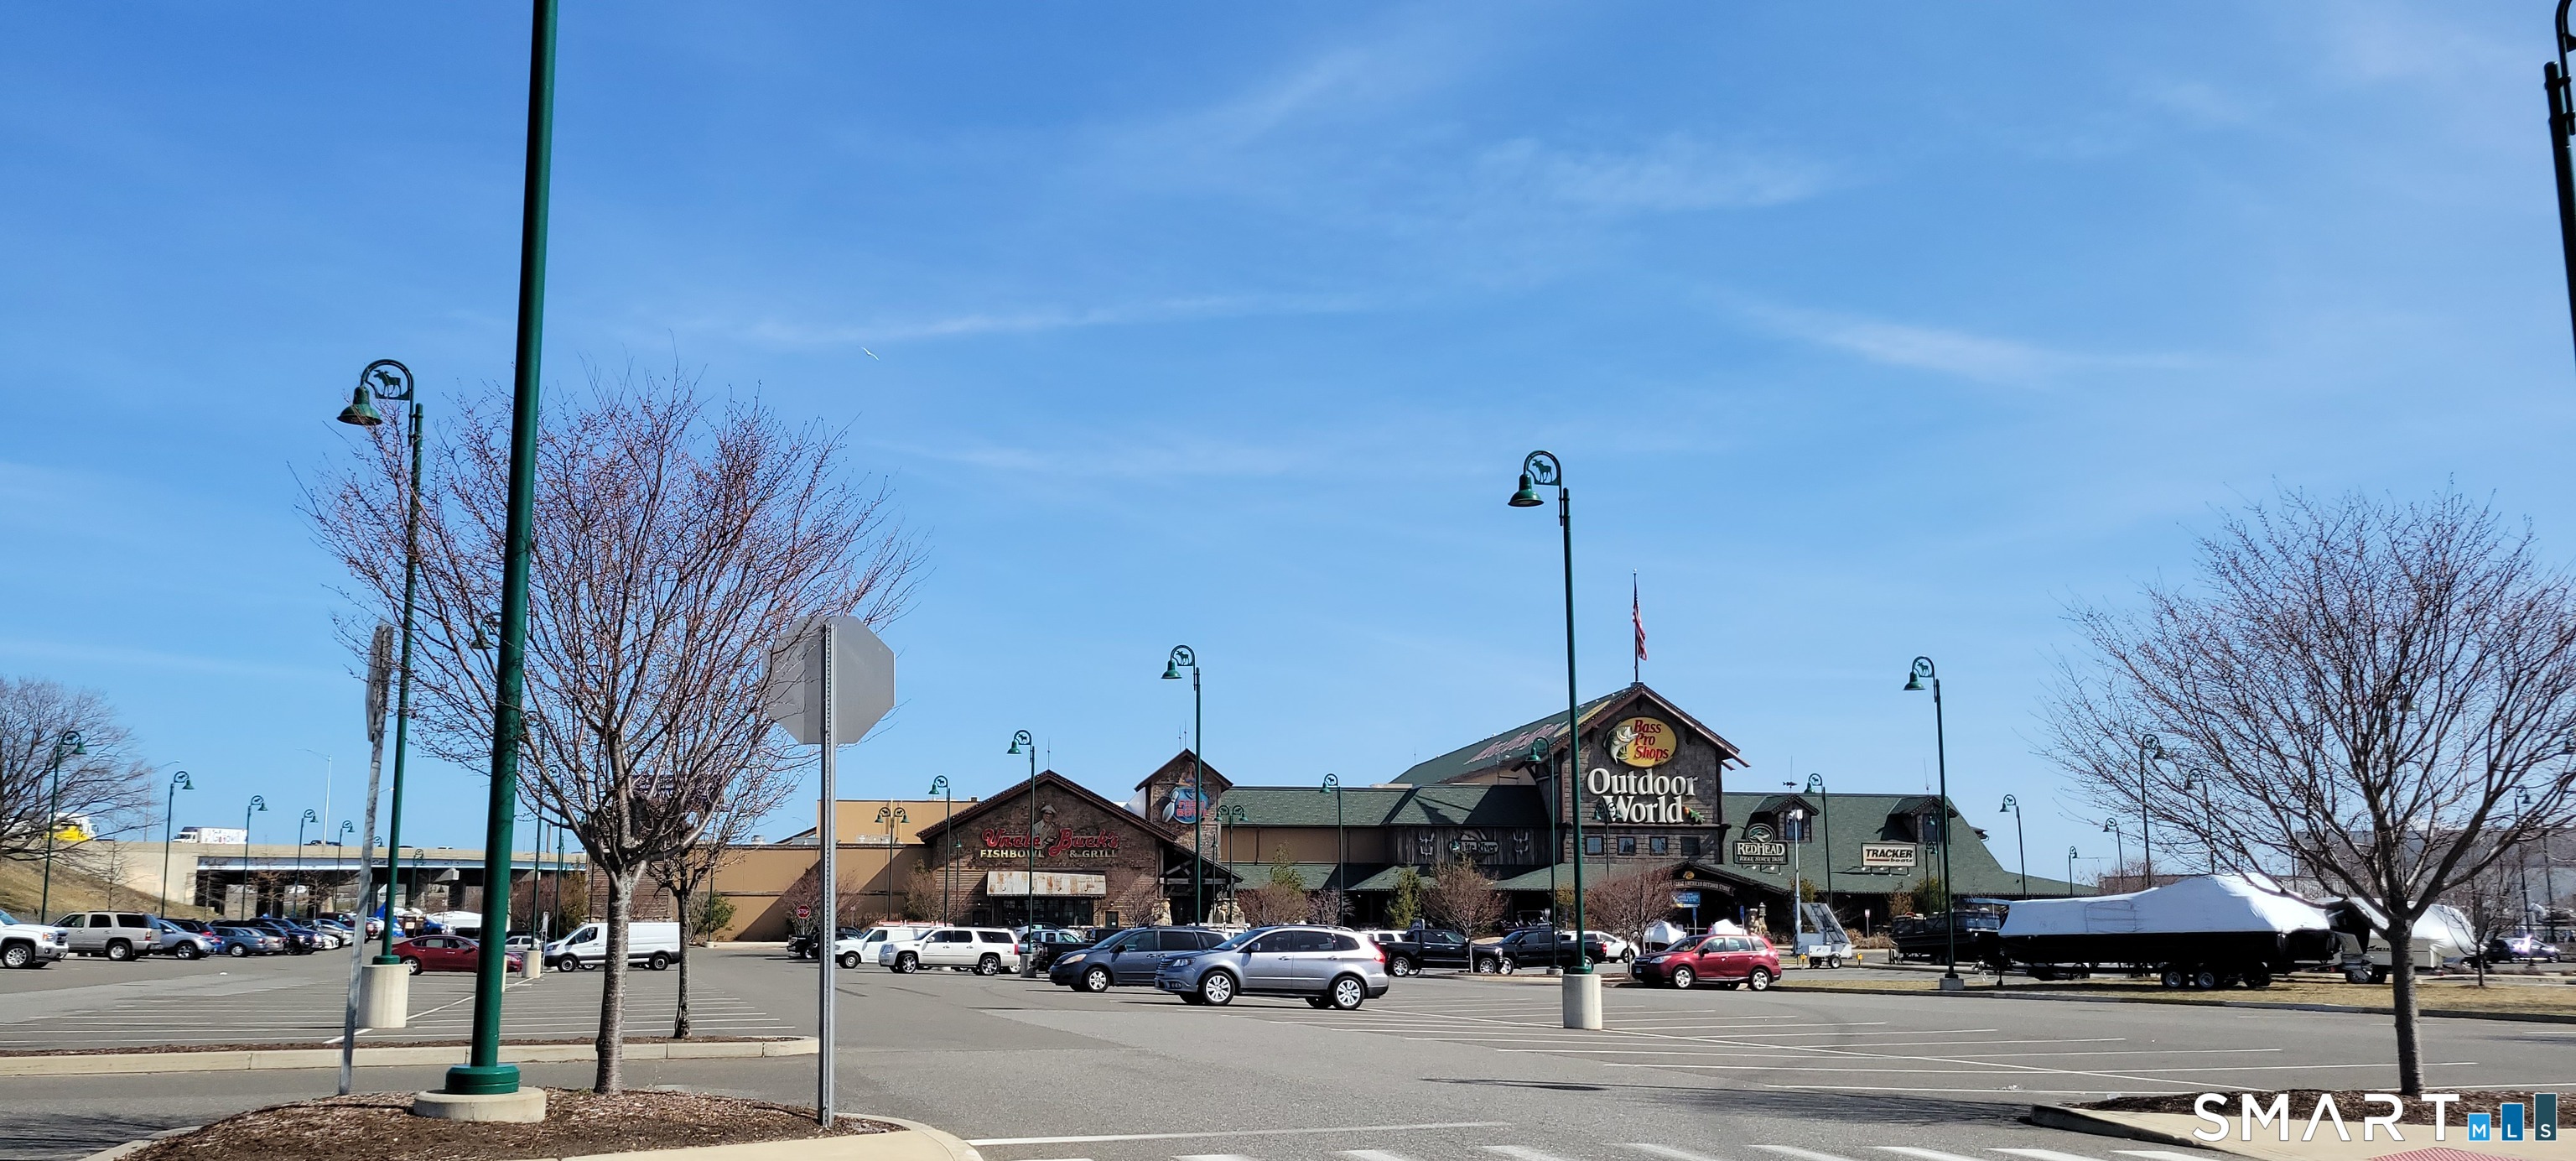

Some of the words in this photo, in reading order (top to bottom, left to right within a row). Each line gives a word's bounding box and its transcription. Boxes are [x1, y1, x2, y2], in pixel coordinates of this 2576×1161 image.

[1634, 720, 1662, 733] Bass
[1635, 733, 1656, 745] Pro
[1634, 746, 1670, 761] Shops
[1587, 768, 1699, 795] Outdoor
[1602, 795, 1684, 823] World
[982, 828, 1041, 848] Uncle
[1049, 828, 1119, 856] Buck's
[1069, 850, 1078, 858] &
[1082, 850, 1117, 858] GRILL
[1452, 842, 1477, 851] hite
[1478, 842, 1498, 852] River
[1866, 849, 1913, 858] TRACKER
